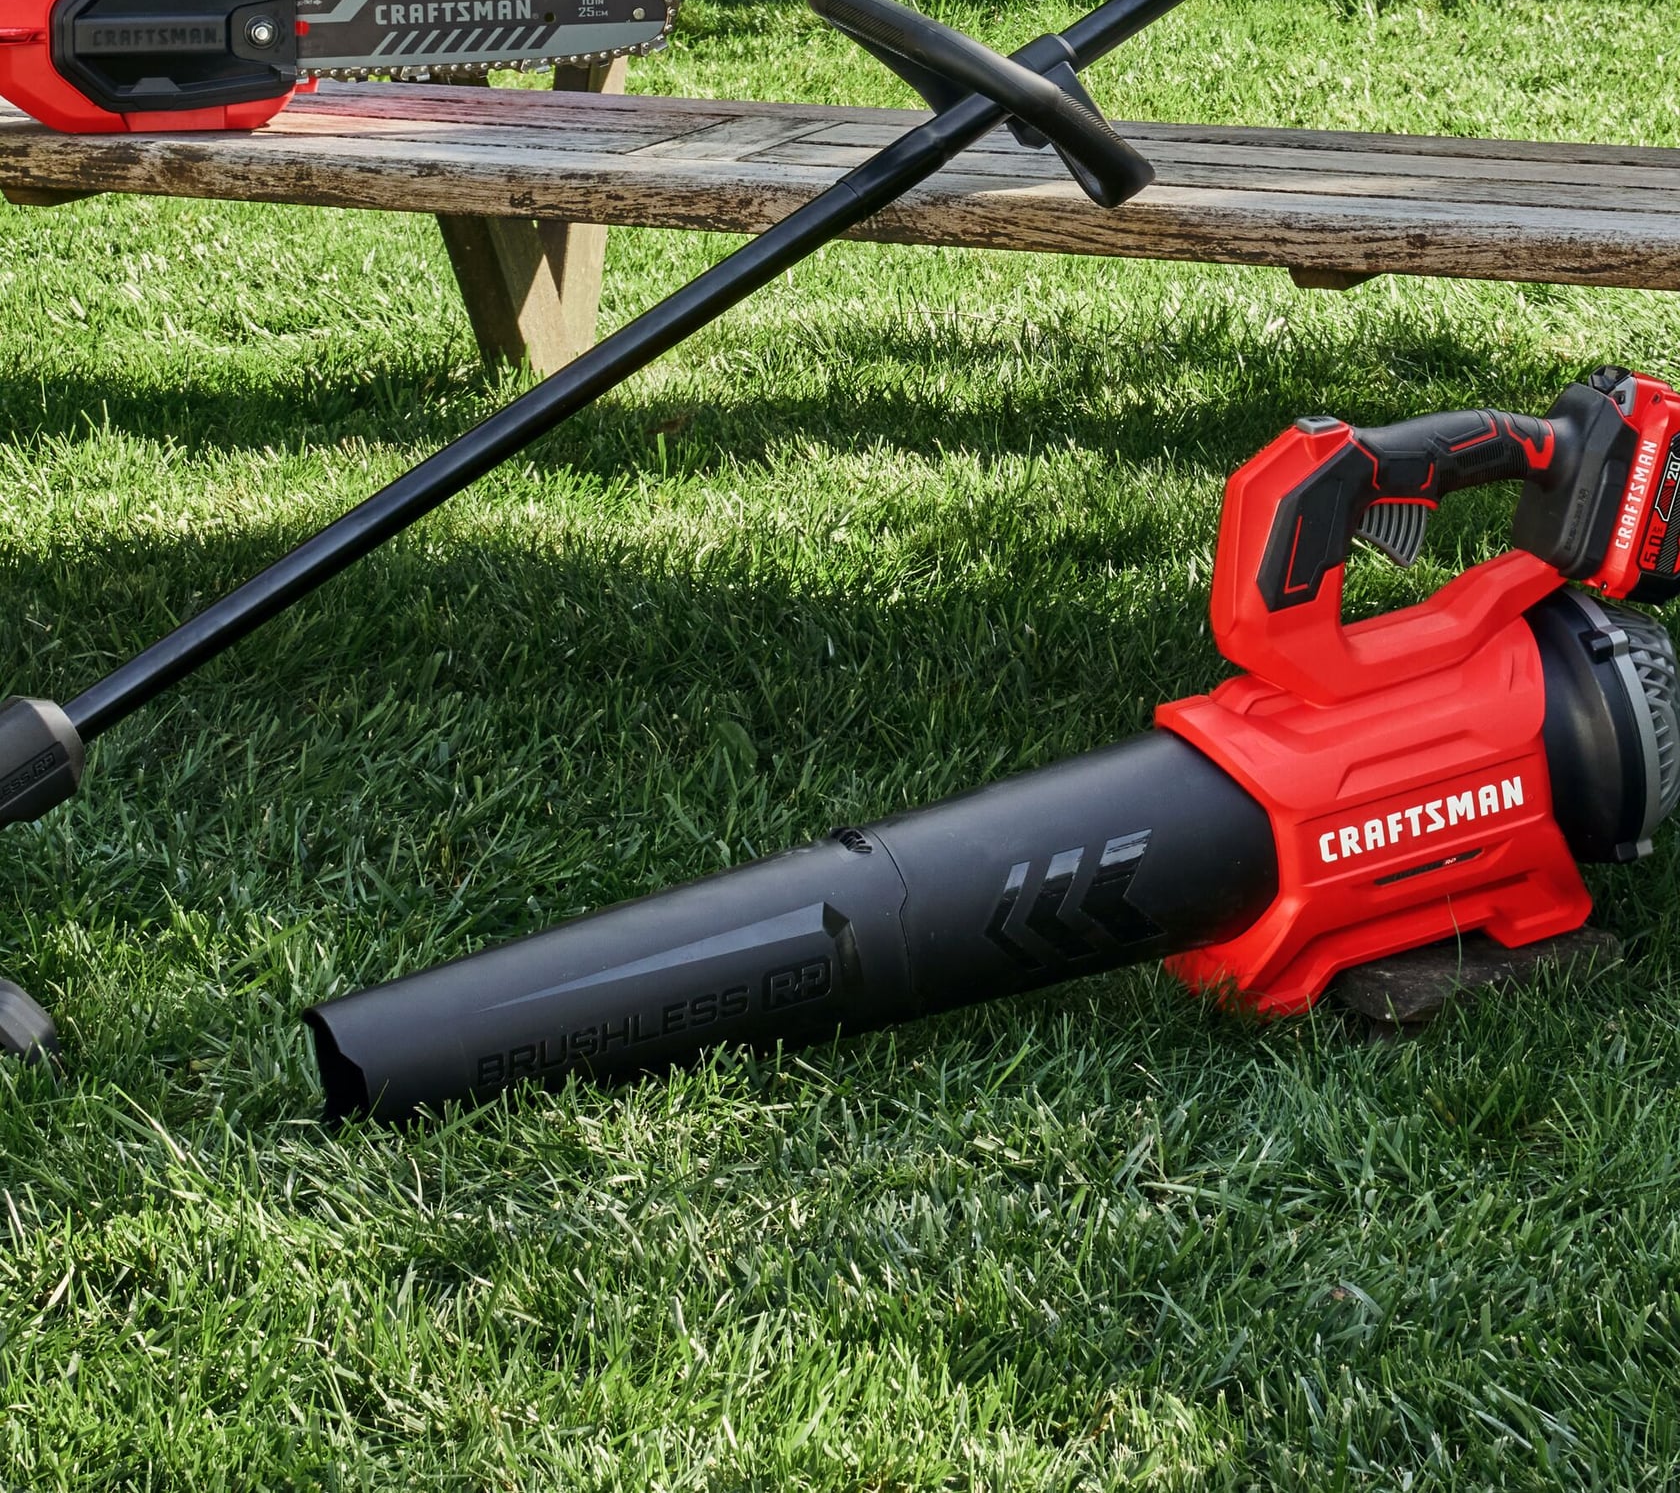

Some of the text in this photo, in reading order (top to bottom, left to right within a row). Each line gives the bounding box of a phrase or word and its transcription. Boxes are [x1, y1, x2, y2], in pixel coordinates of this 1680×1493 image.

[93, 27, 217, 46] CRAFTSMAN
[375, 0, 531, 25] CRAFTSMAN
[1616, 441, 1657, 550] CRAFTSMAN
[1319, 776, 1524, 863] CRAFTSMAN
[478, 985, 749, 1087] BRUSHLESS
